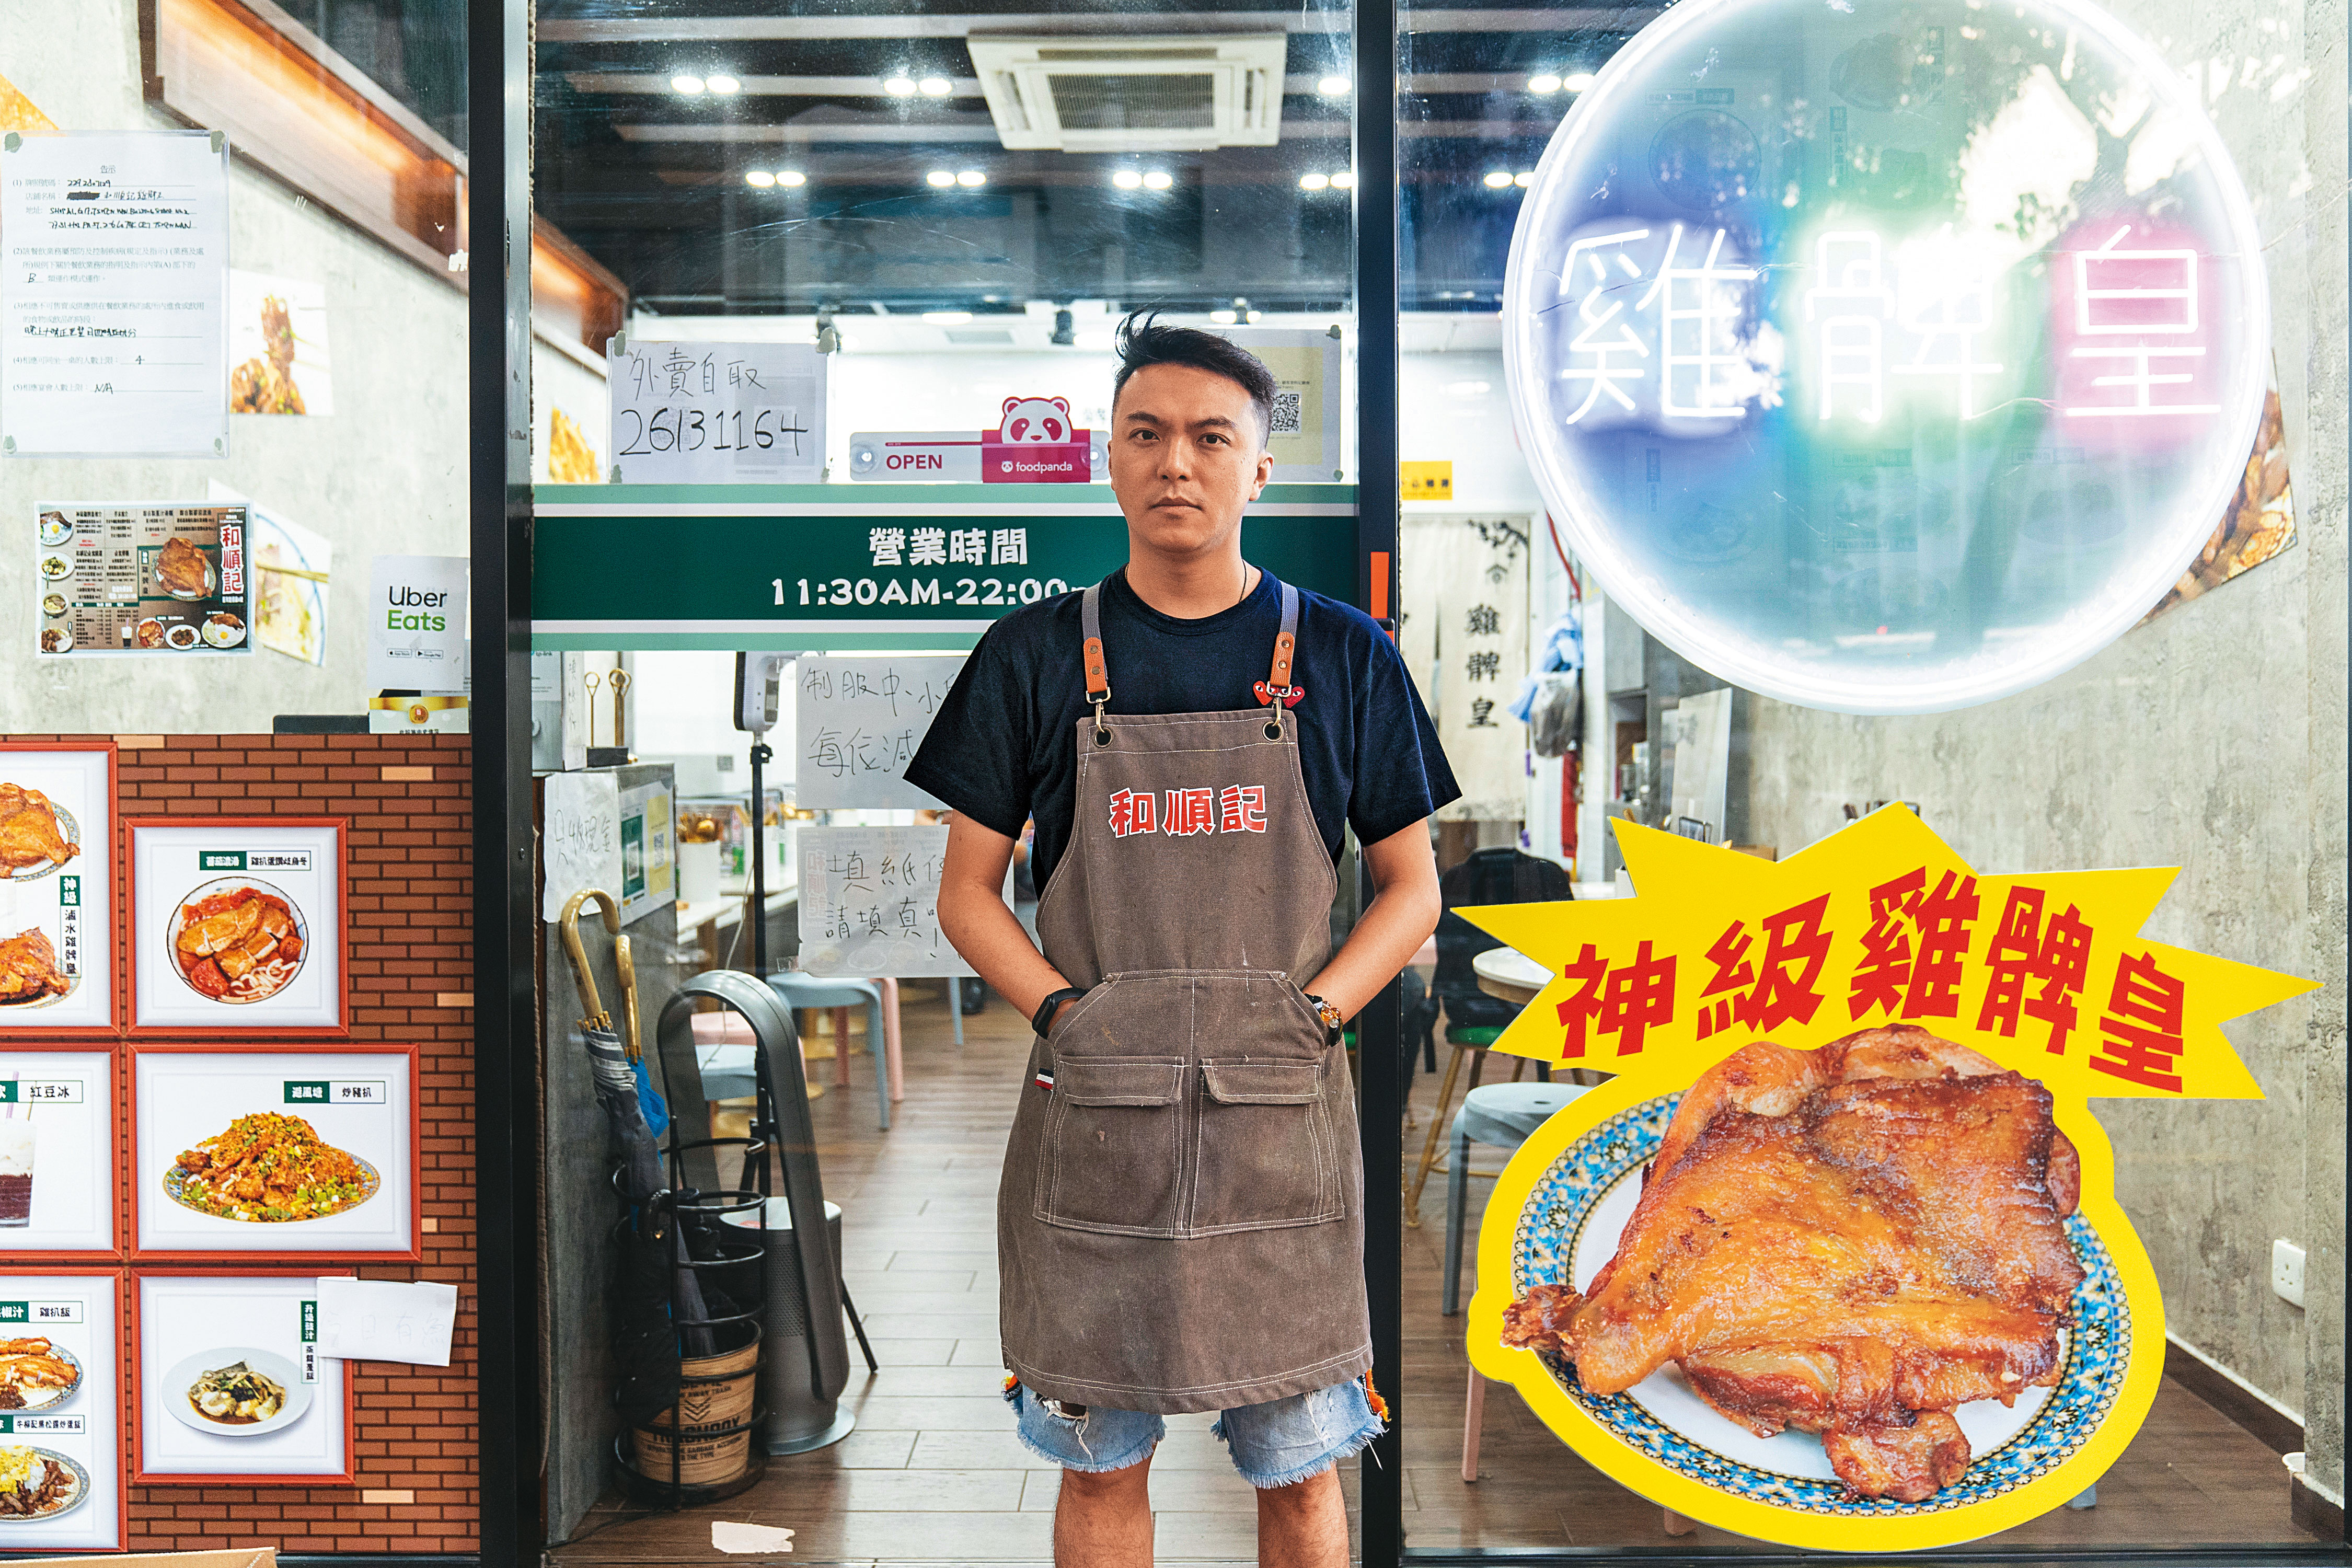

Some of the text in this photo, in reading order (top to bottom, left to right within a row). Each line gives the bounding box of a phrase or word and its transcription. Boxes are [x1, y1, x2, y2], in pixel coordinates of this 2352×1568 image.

[628, 347, 767, 401] 外賣自取
[619, 407, 809, 456] 26131164
[886, 454, 943, 470] OPEN
[1016, 460, 1073, 474] foodpanda
[220, 524, 245, 595] 和順記
[869, 527, 1028, 567] 營業時間
[389, 585, 448, 608] Uber
[387, 609, 446, 632] Eats
[1465, 603, 1502, 729] 雞髀皇
[1109, 784, 1267, 838] 和順記
[64, 877, 77, 904] 神級
[1557, 865, 2185, 1093] 神級雞髀皇
[30, 1085, 70, 1098] 紅豆冰
[0, 1306, 24, 1318] 椒汁
